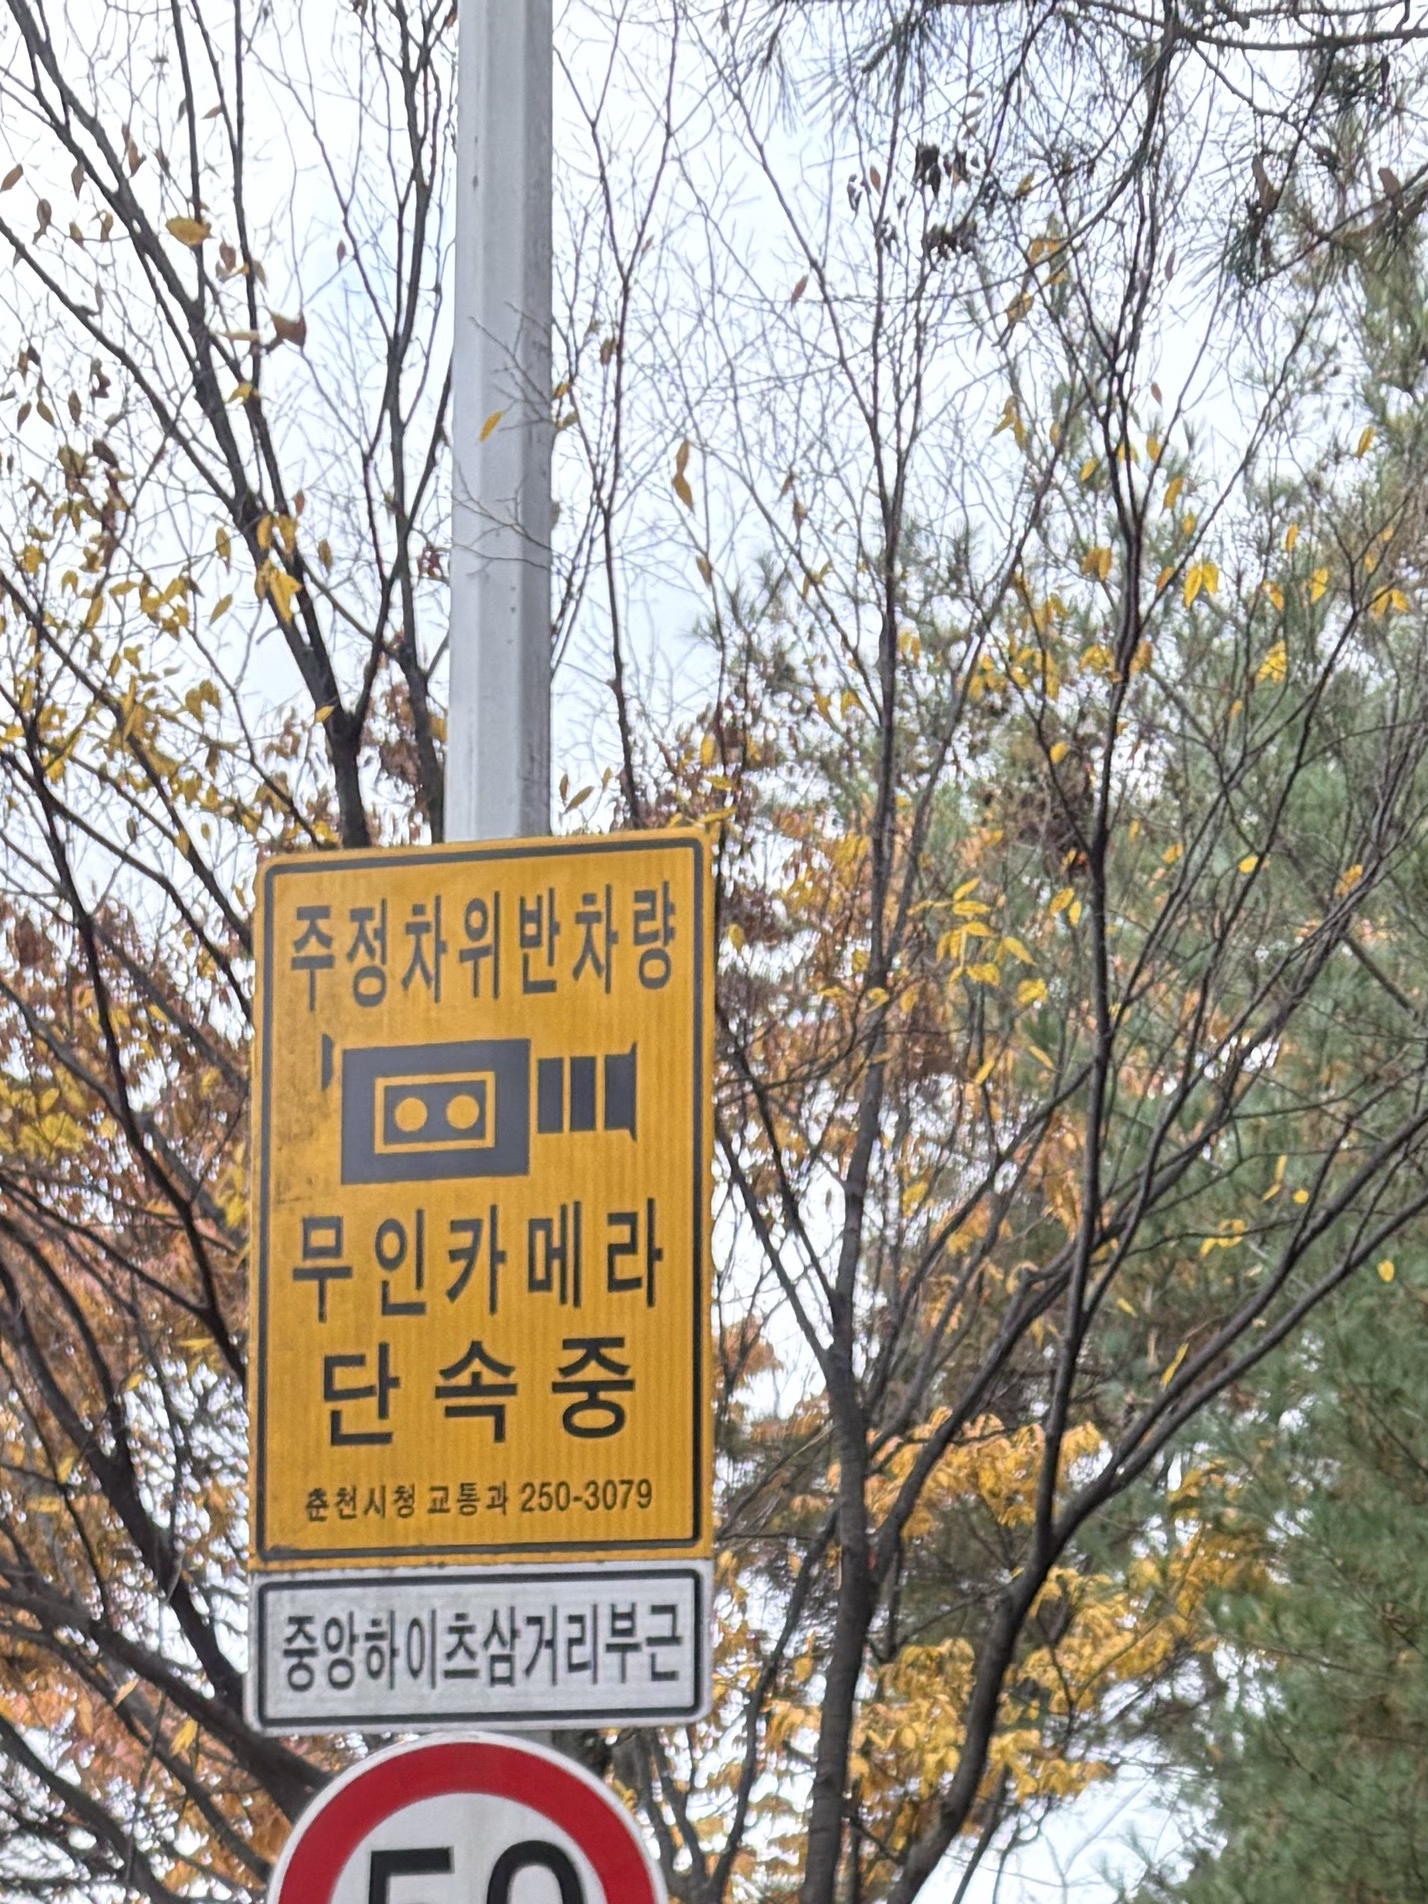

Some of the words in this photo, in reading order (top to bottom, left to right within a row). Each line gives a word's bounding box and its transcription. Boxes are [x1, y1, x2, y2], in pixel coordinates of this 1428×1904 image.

[290, 881, 676, 1013] 주정차위반차량
[292, 1197, 663, 1323] 무인카메라
[324, 1336, 636, 1447] 단속중
[305, 1483, 416, 1523] 춘천시청
[427, 1480, 510, 1517] 교통과
[520, 1478, 653, 1514] 250-3079
